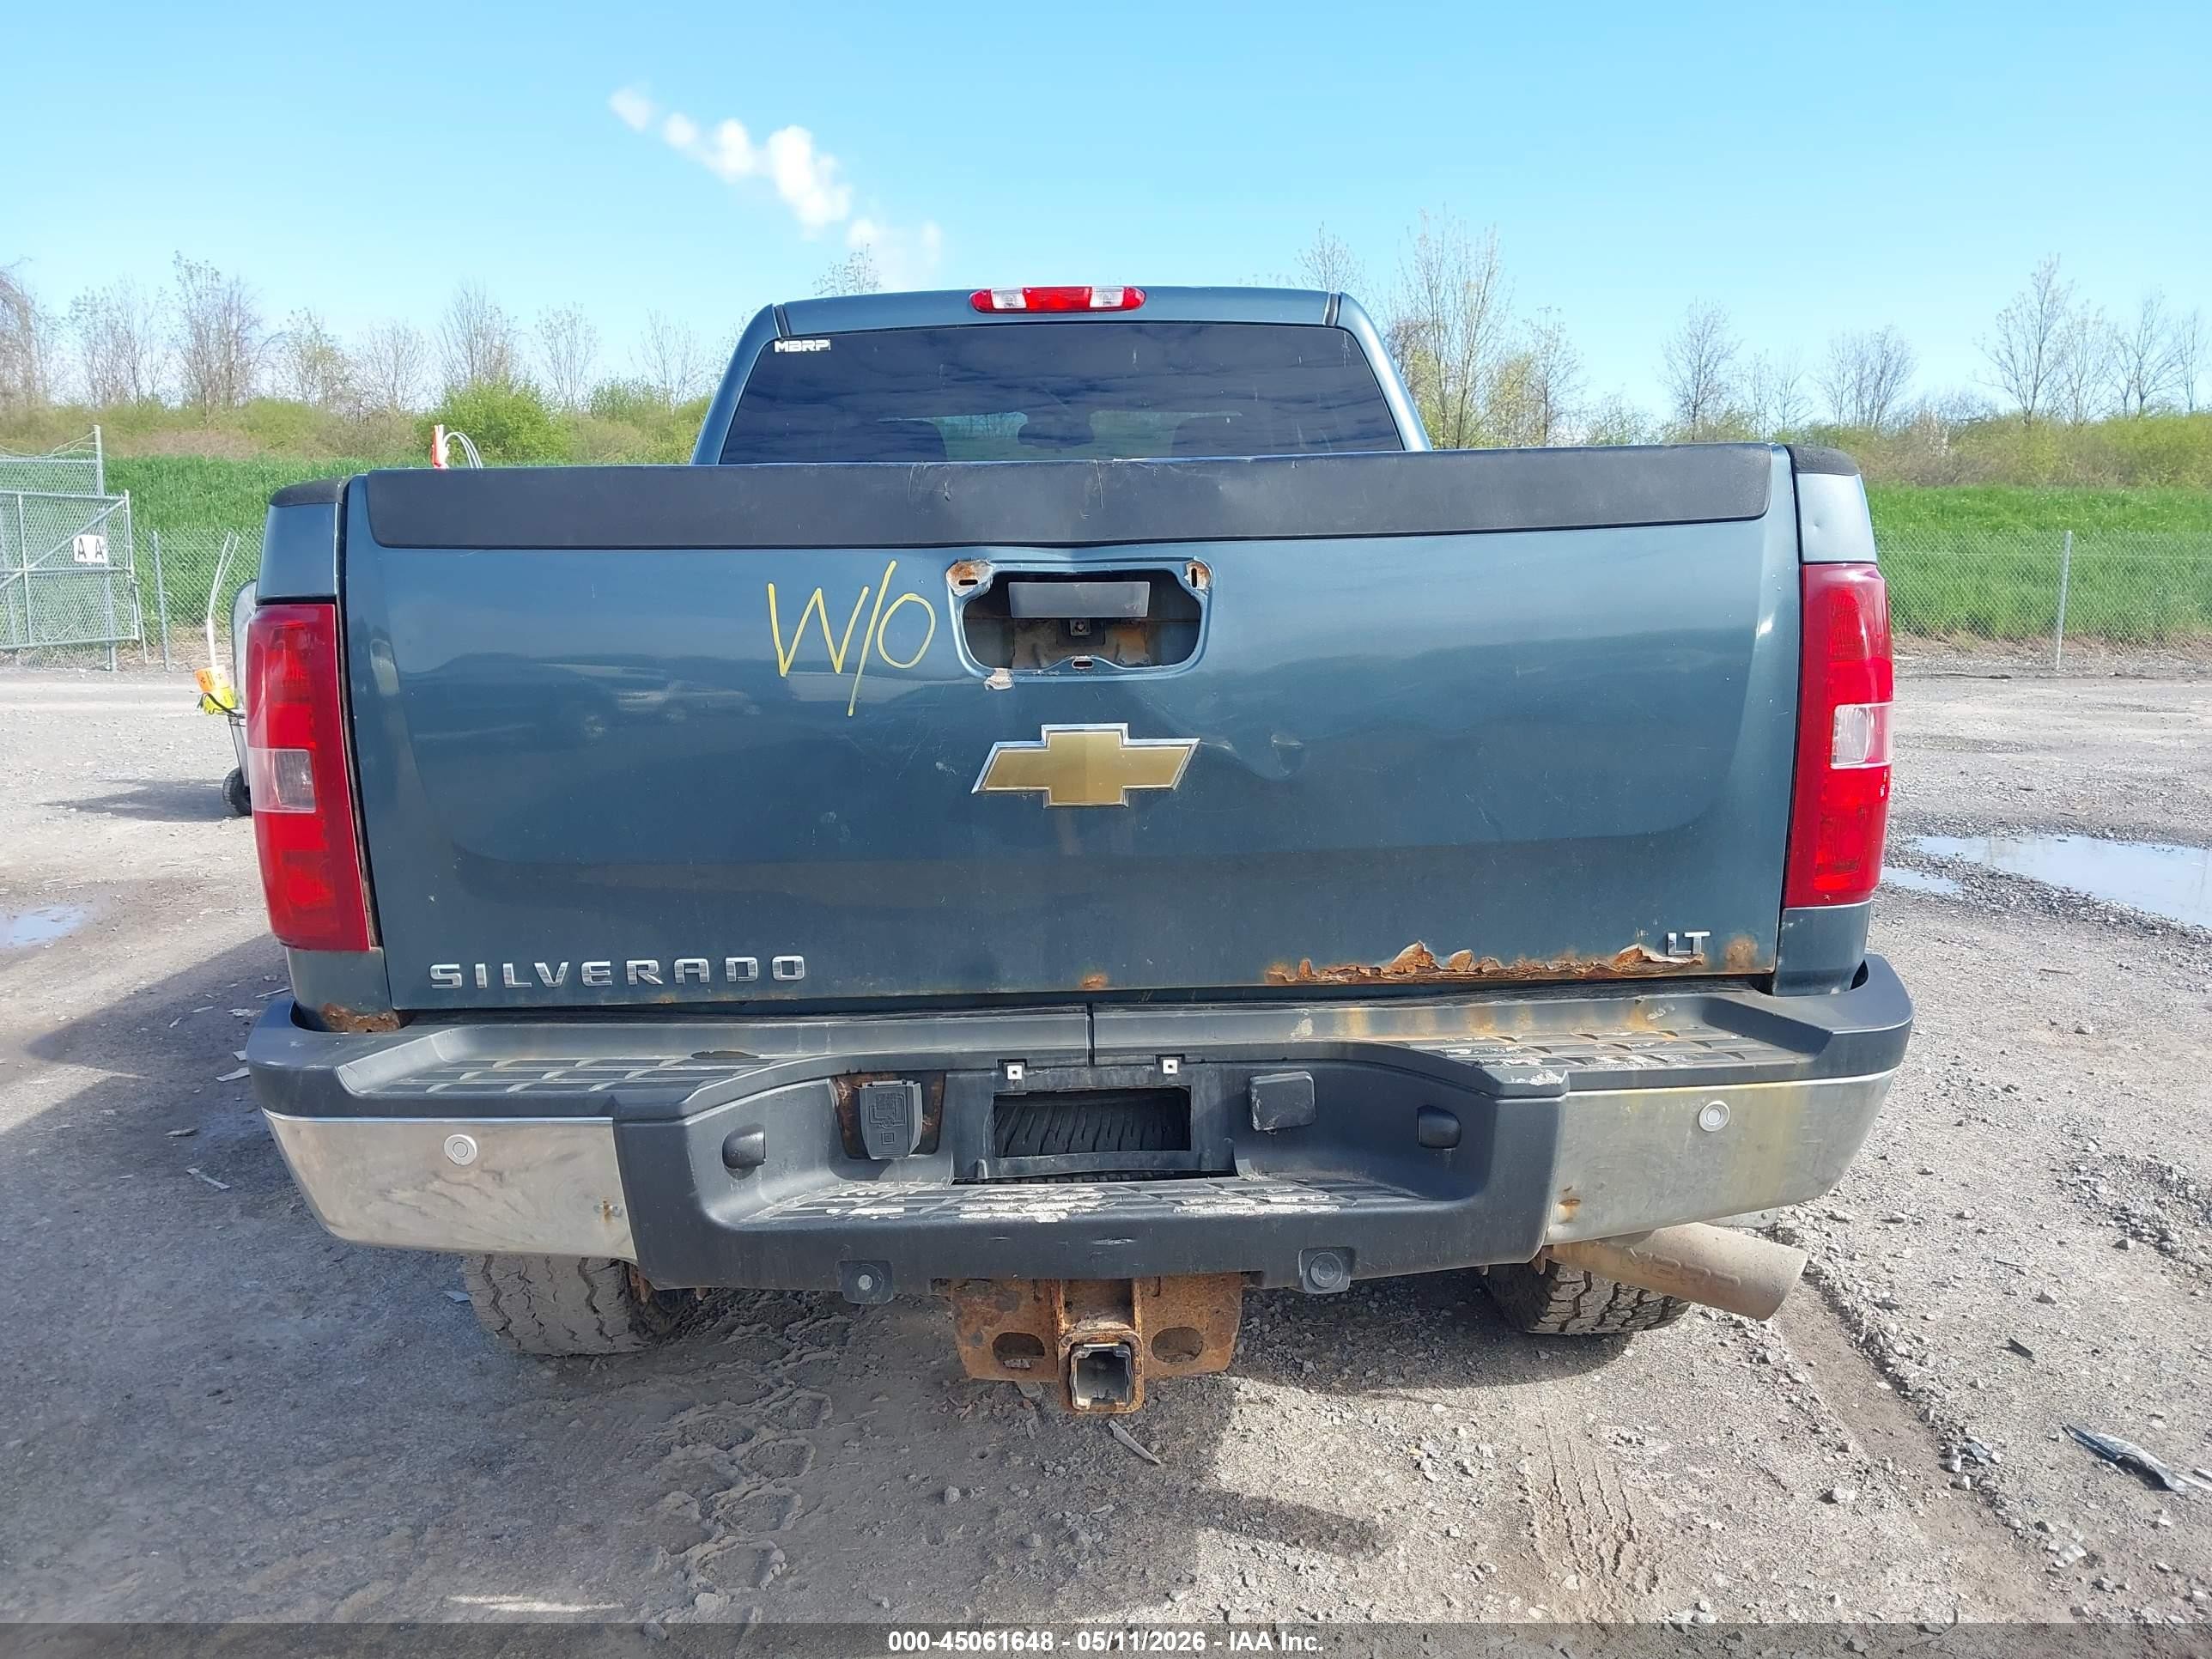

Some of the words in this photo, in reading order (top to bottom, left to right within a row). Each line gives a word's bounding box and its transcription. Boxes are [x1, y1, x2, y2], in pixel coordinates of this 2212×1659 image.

[774, 339, 830, 353] MBRP
[1668, 931, 1711, 956] LT
[429, 955, 805, 989] SILVERADO
